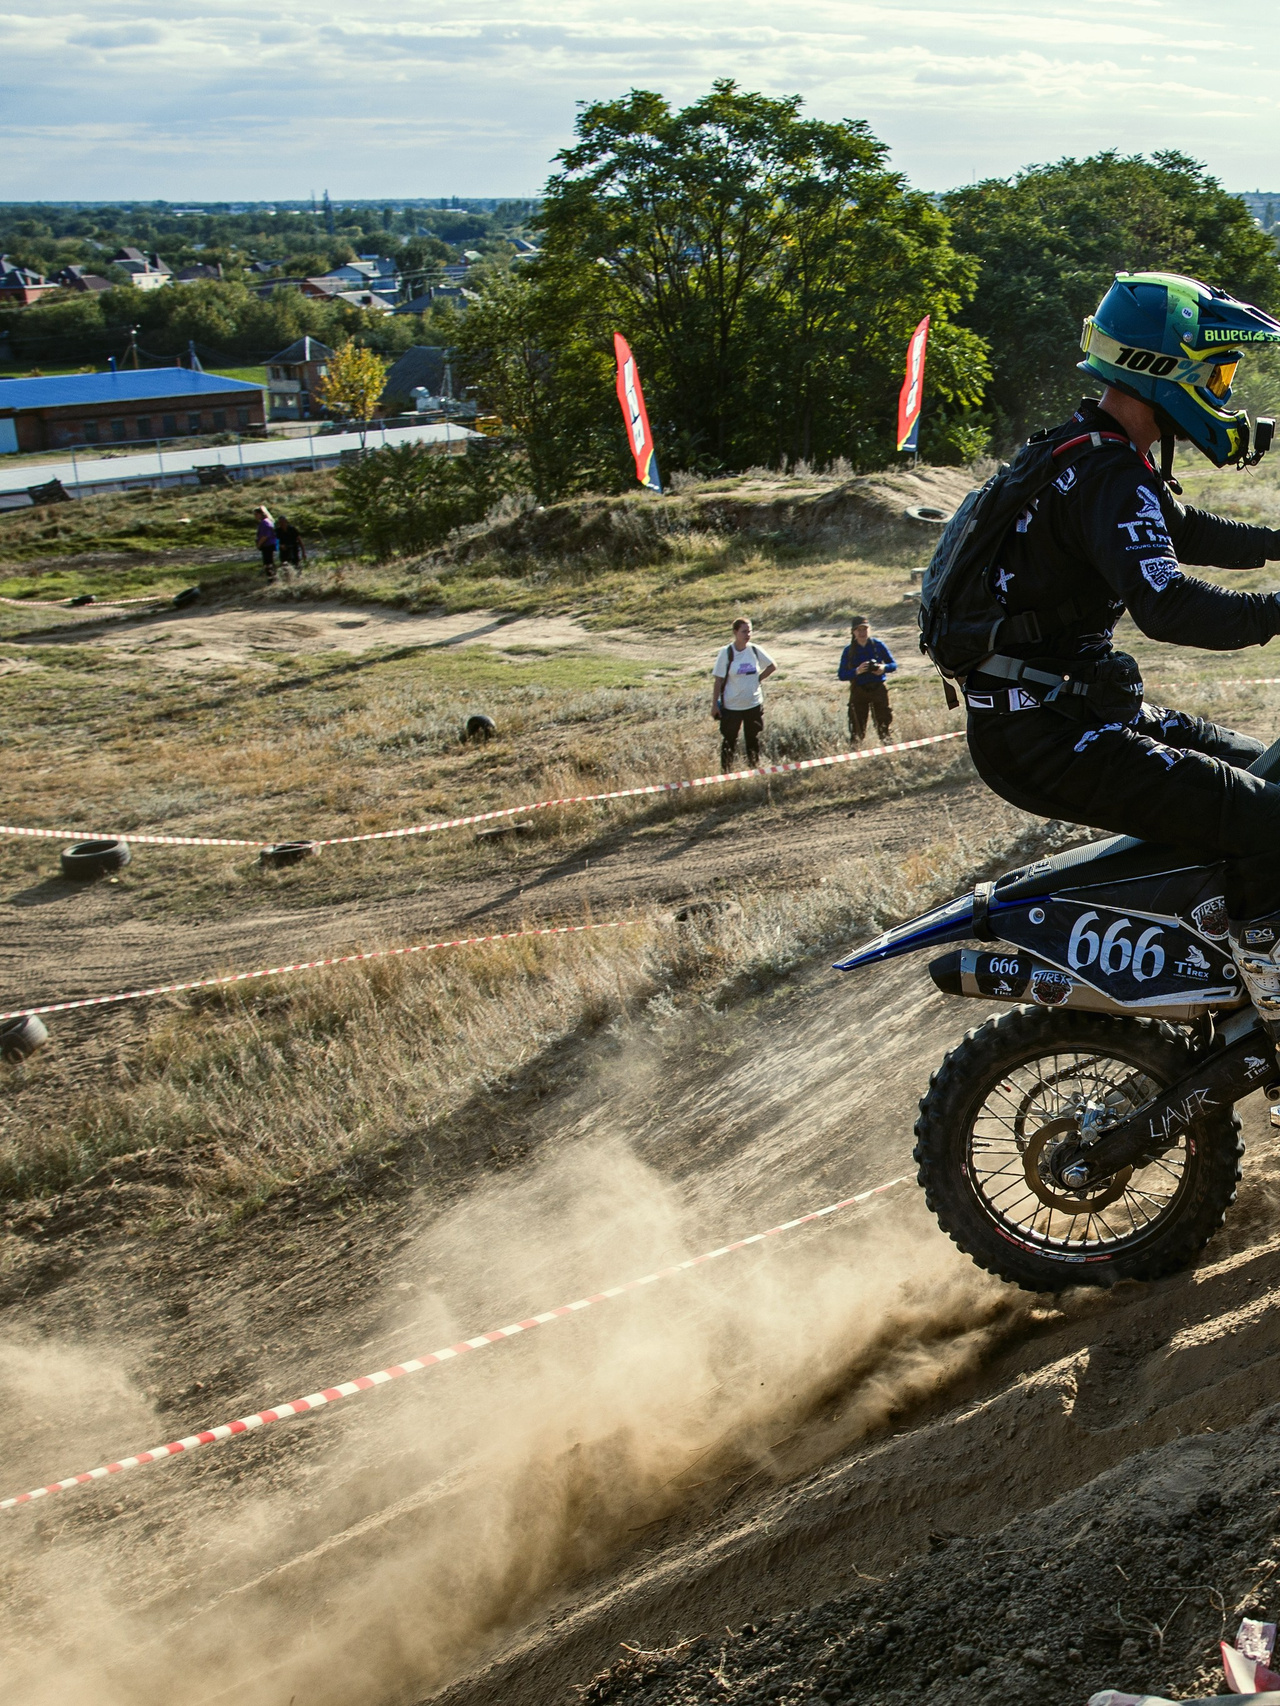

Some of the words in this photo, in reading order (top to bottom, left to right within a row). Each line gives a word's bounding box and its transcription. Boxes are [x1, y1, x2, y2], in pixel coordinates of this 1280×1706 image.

[1114, 347, 1205, 383] 100%
[1067, 910, 1166, 983] 666
[990, 957, 1019, 976] 666
